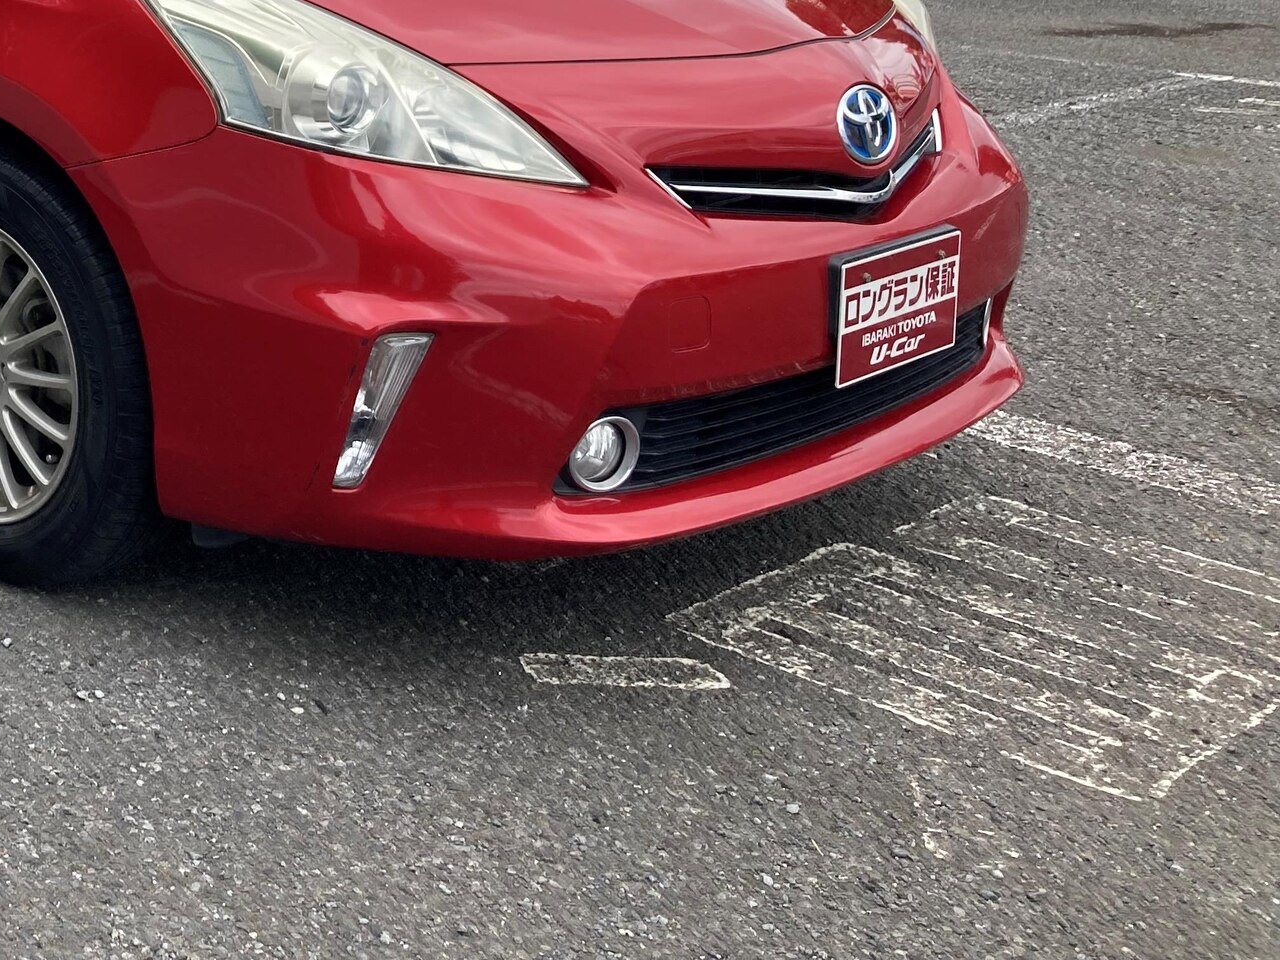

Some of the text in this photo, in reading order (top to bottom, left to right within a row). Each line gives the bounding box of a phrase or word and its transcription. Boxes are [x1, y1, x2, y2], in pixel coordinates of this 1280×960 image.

[844, 260, 956, 328] ロングラン保証
[862, 311, 937, 347] IBARAKI TOYOTA
